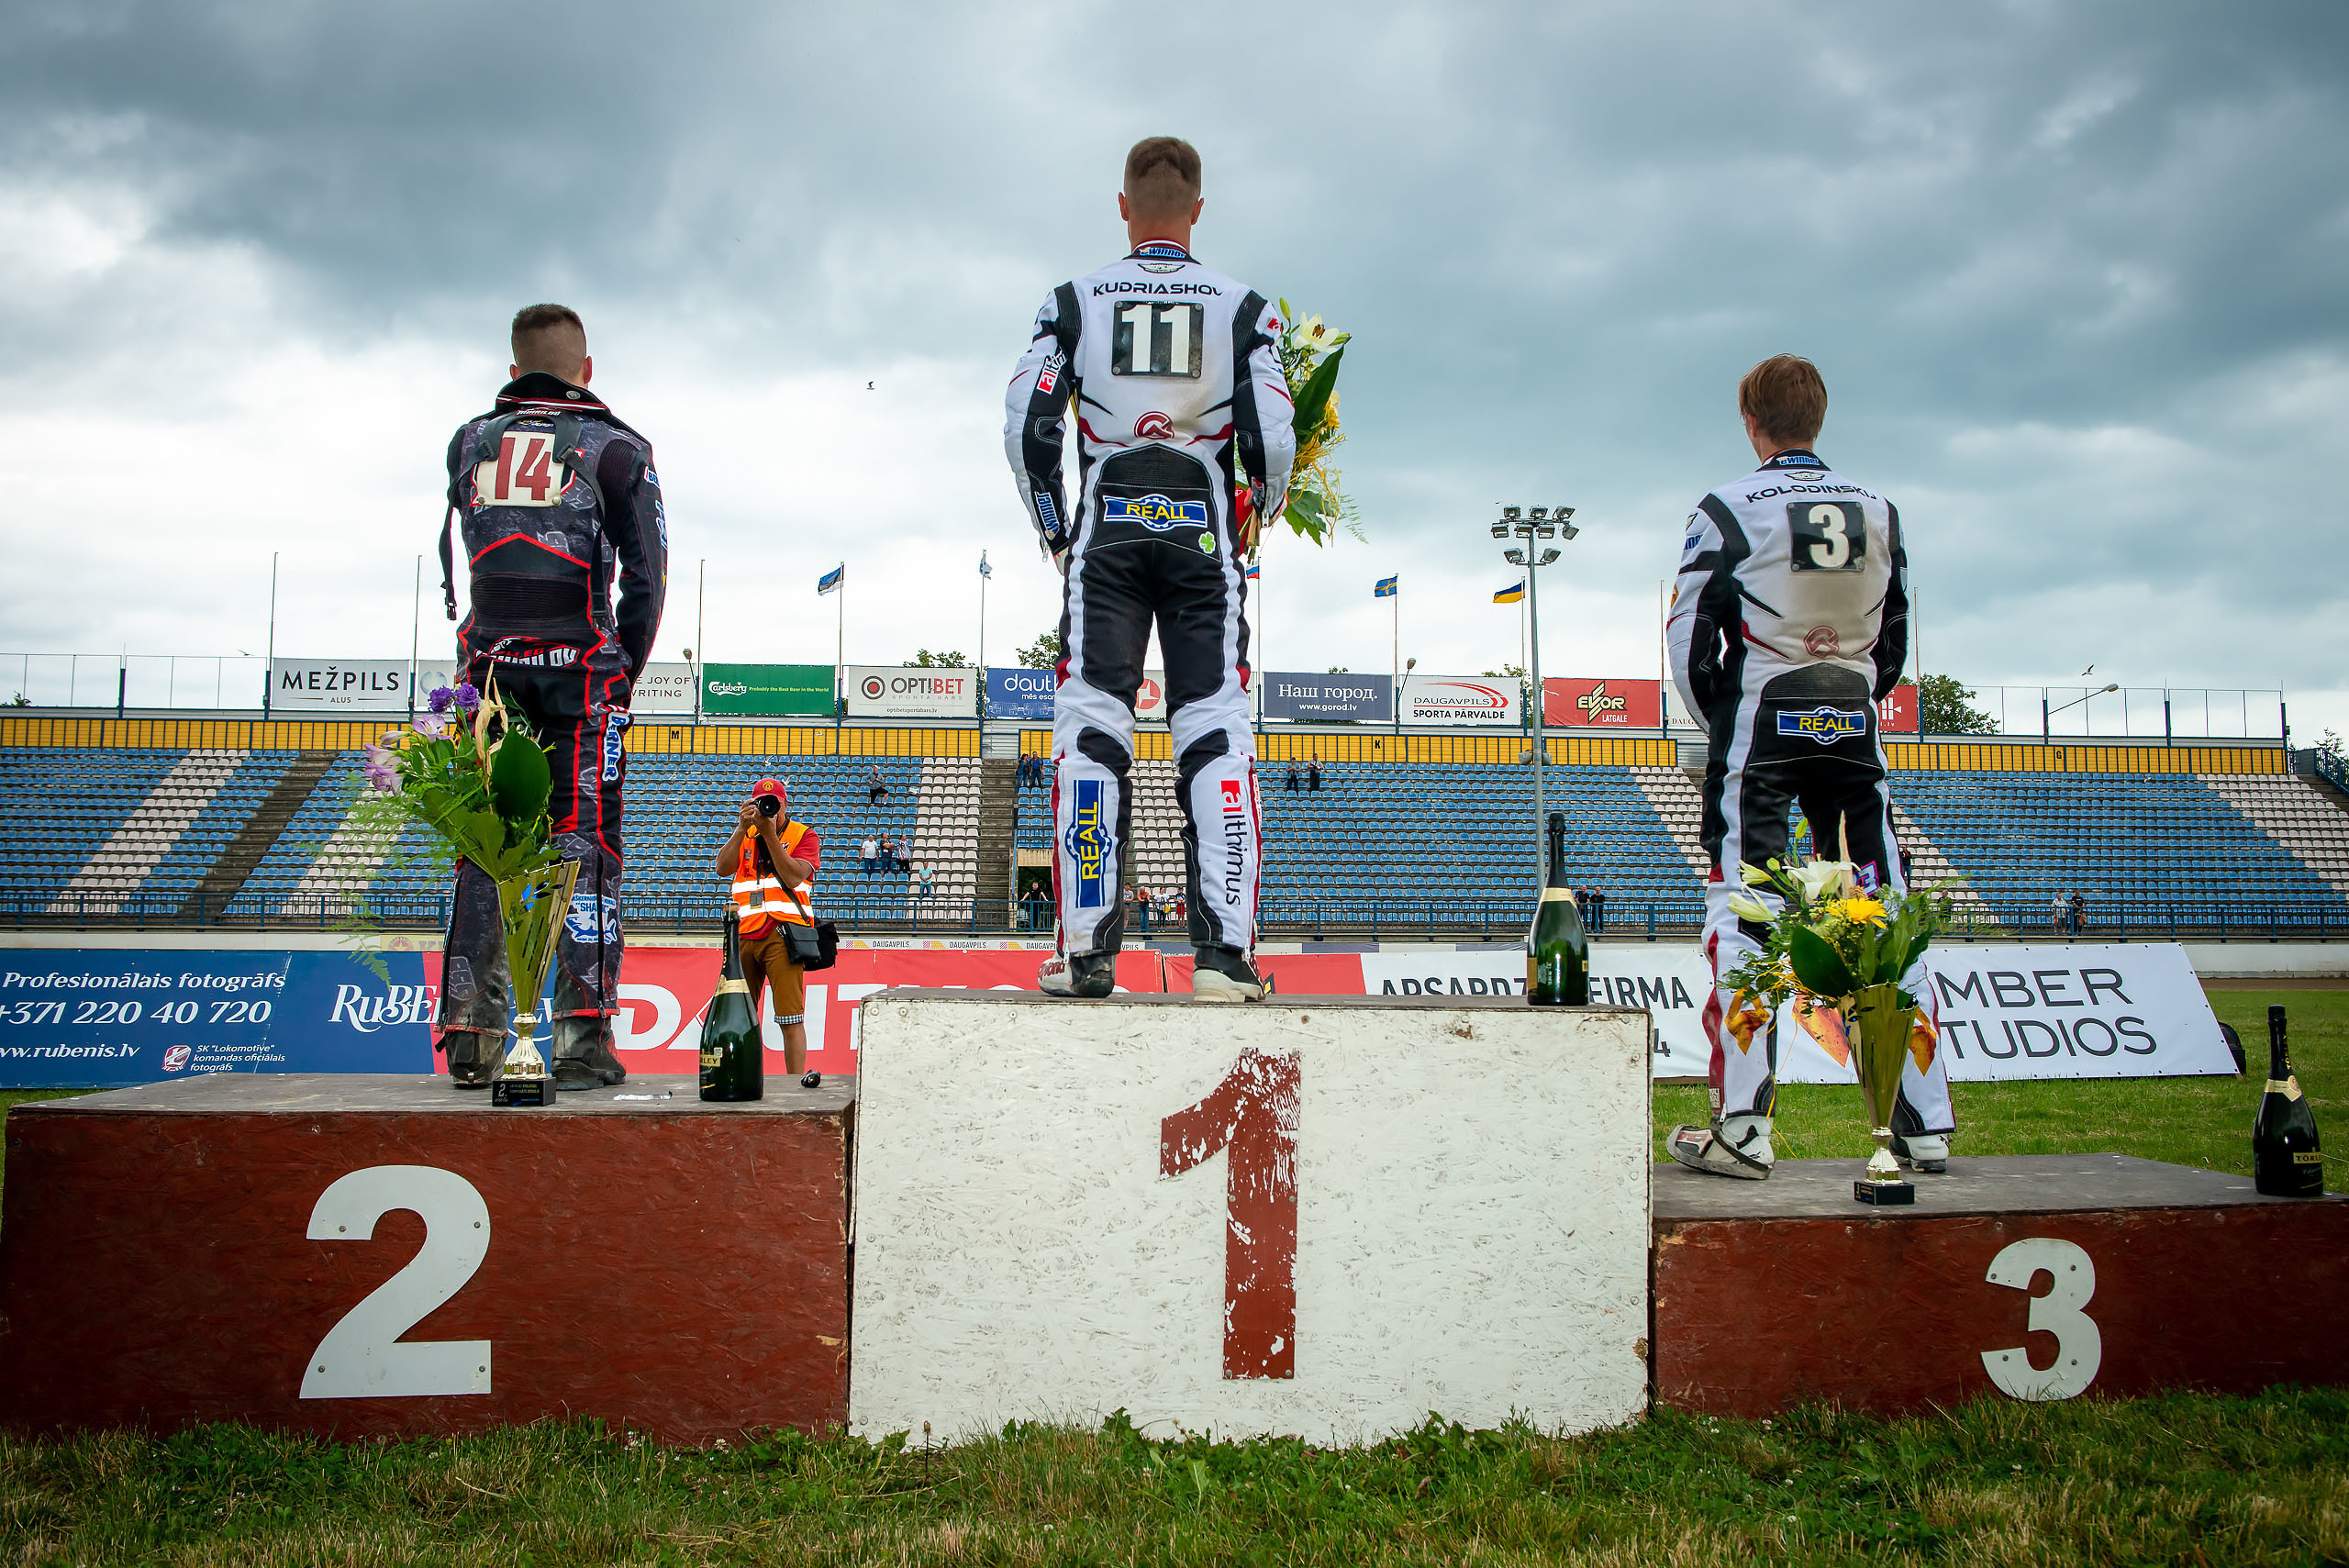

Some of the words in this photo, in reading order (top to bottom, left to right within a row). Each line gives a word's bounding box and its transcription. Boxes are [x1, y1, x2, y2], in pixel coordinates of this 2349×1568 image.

[1120, 304, 1190, 373] 11
[495, 437, 551, 501] 14
[1126, 504, 1190, 521] REALL
[1809, 504, 1850, 569] 3
[282, 666, 399, 691] MEŽPILS
[708, 681, 747, 695] Carlsberg
[1277, 684, 1319, 698] Наш
[1323, 686, 1378, 702] город.
[1414, 697, 1490, 706] DAUGAVPILS
[1299, 703, 1358, 712] www.gorod.lv
[1413, 709, 1452, 718] SPORTA
[1454, 708, 1505, 719] PĀRVALDE
[1602, 715, 1628, 723] LATGALE
[1799, 717, 1855, 731] REALL
[672, 731, 680, 740] M
[1375, 740, 1382, 749] K
[605, 715, 627, 779] BERNER
[2055, 750, 2063, 760] G
[1079, 802, 1100, 881] REALL
[2, 973, 172, 988] Profesionālais
[178, 973, 285, 992] fotogrāfs
[1934, 968, 2133, 1007] MBER
[0, 1001, 67, 1024] +371
[72, 1001, 142, 1024] 220
[150, 1001, 199, 1024] 40
[208, 1001, 272, 1023] 720
[1939, 1016, 2156, 1059] TUDIOS
[190, 1063, 233, 1073] fotogrāfs
[1160, 1048, 1301, 1380] 1
[299, 1164, 491, 1400] 2
[1980, 1237, 2102, 1402] 3
